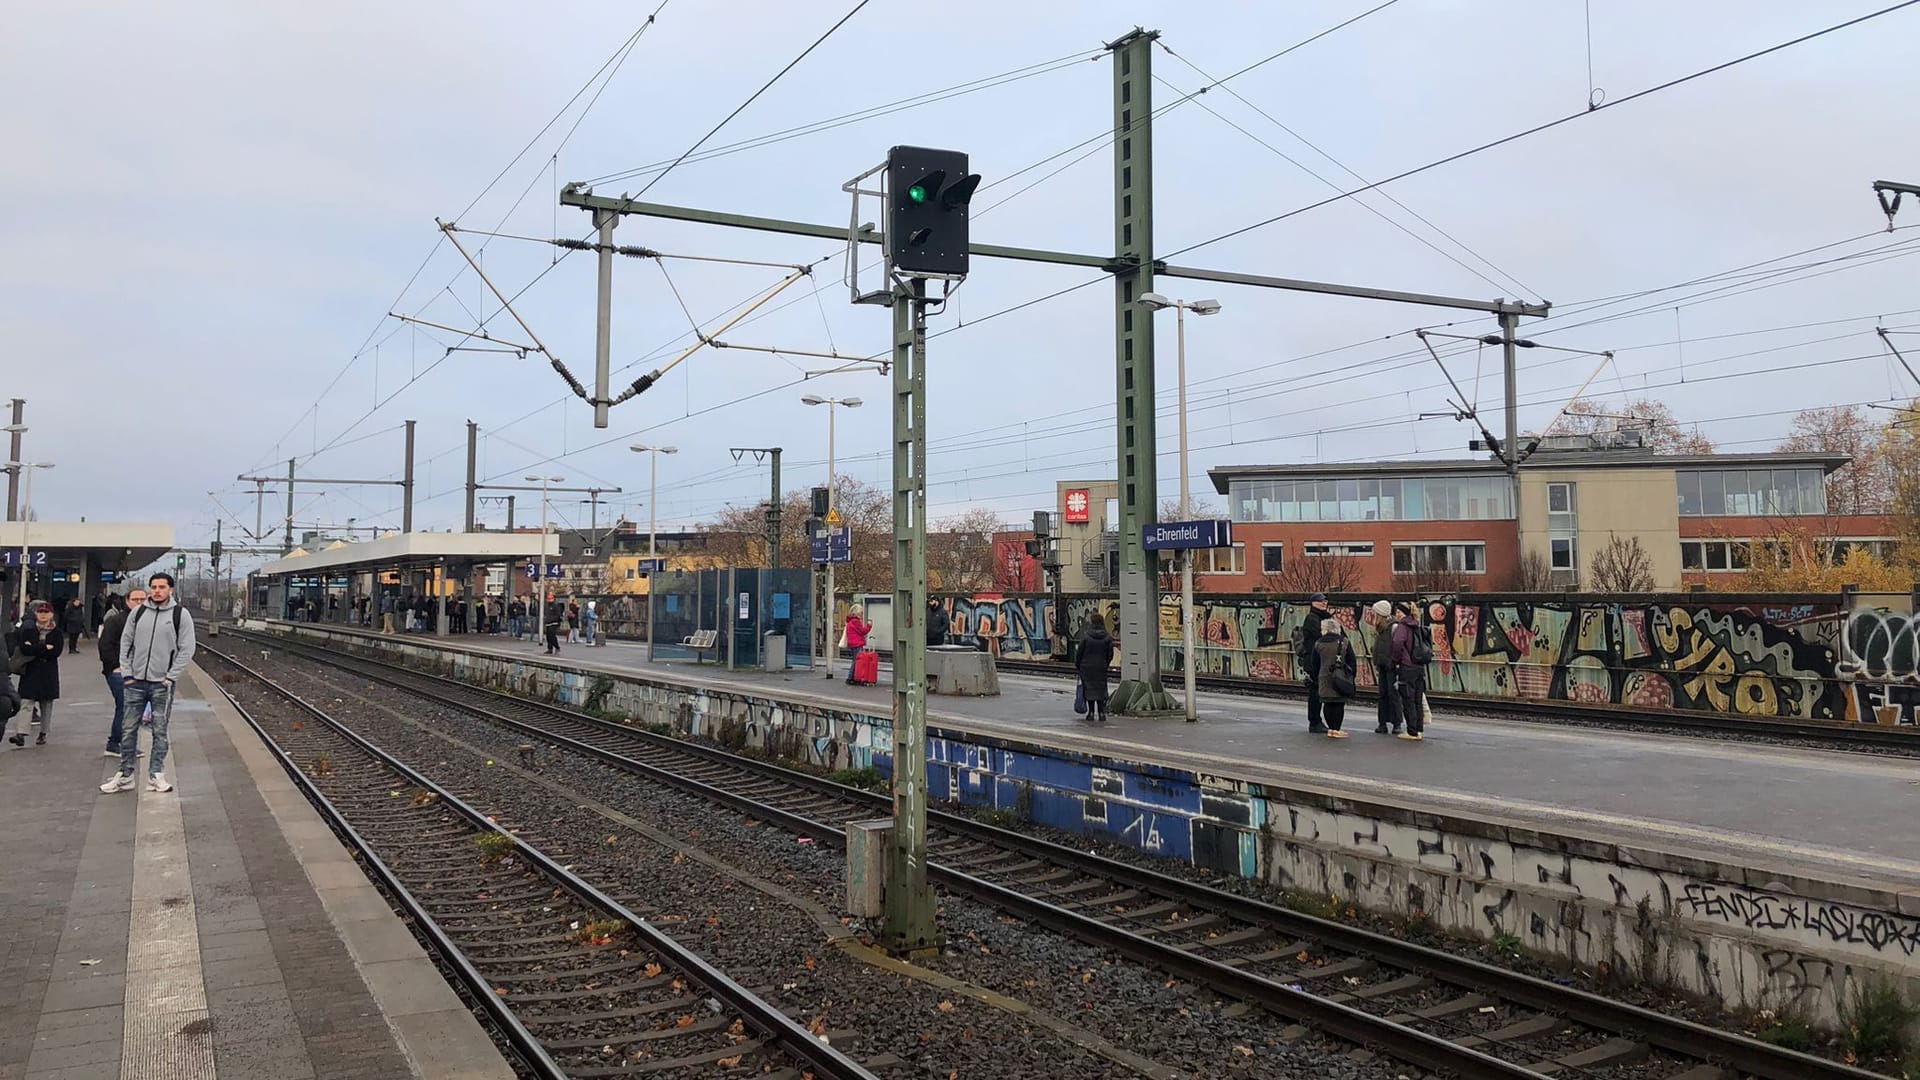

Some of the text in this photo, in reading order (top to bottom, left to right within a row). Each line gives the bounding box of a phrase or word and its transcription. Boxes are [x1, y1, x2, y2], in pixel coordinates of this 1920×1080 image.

[1157, 525, 1198, 542] Ehrenfeld
[4, 552, 10, 563] 1
[36, 551, 46, 564] 2
[527, 563, 535, 576] 3
[551, 564, 560, 575] 4
